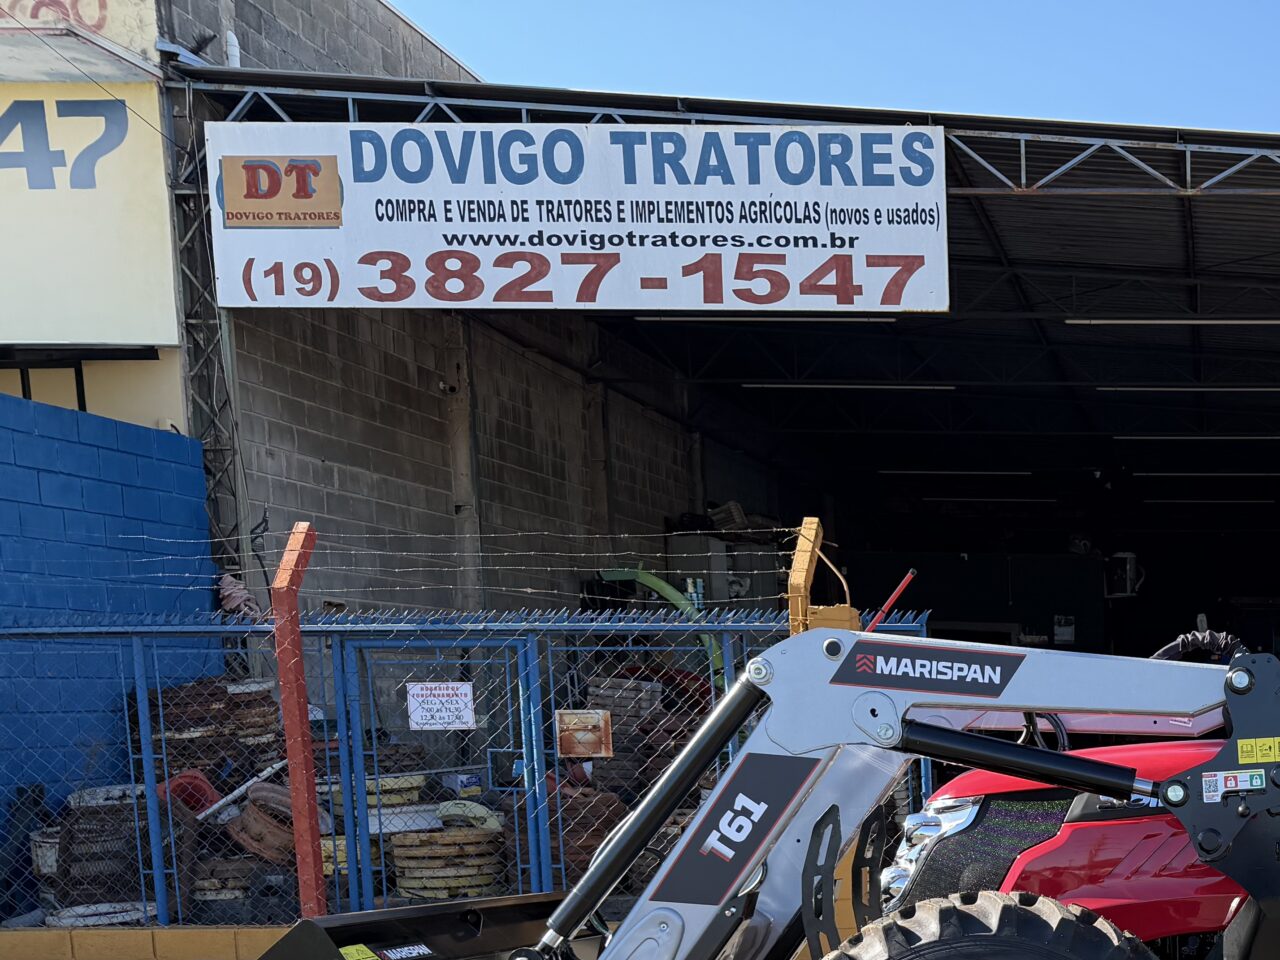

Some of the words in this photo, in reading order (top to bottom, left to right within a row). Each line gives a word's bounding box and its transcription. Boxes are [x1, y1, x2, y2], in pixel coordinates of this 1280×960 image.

[0, 100, 128, 190] 47
[350, 128, 585, 185] DOVIGO
[609, 131, 935, 187] TRATORES
[241, 159, 322, 200] DT
[226, 211, 274, 221] DOVIGO
[276, 211, 340, 221] TRATORES
[375, 198, 437, 223] COMPRA
[444, 199, 452, 223] E
[456, 199, 507, 223] VENDA
[511, 199, 530, 223] DE
[535, 199, 613, 223] TRATORES
[617, 199, 626, 223] E
[630, 200, 734, 224] IMPLEMENTOS
[825, 201, 870, 231] (novos
[874, 210, 883, 226] e
[886, 201, 941, 231] usados)
[442, 229, 860, 251] www.dovigotratores.com.br
[242, 257, 340, 302] (19)
[357, 249, 925, 306] 3827-1547
[876, 655, 1001, 685] MARISPAN
[699, 792, 769, 862] T61
[383, 944, 433, 960] MARISPAN
